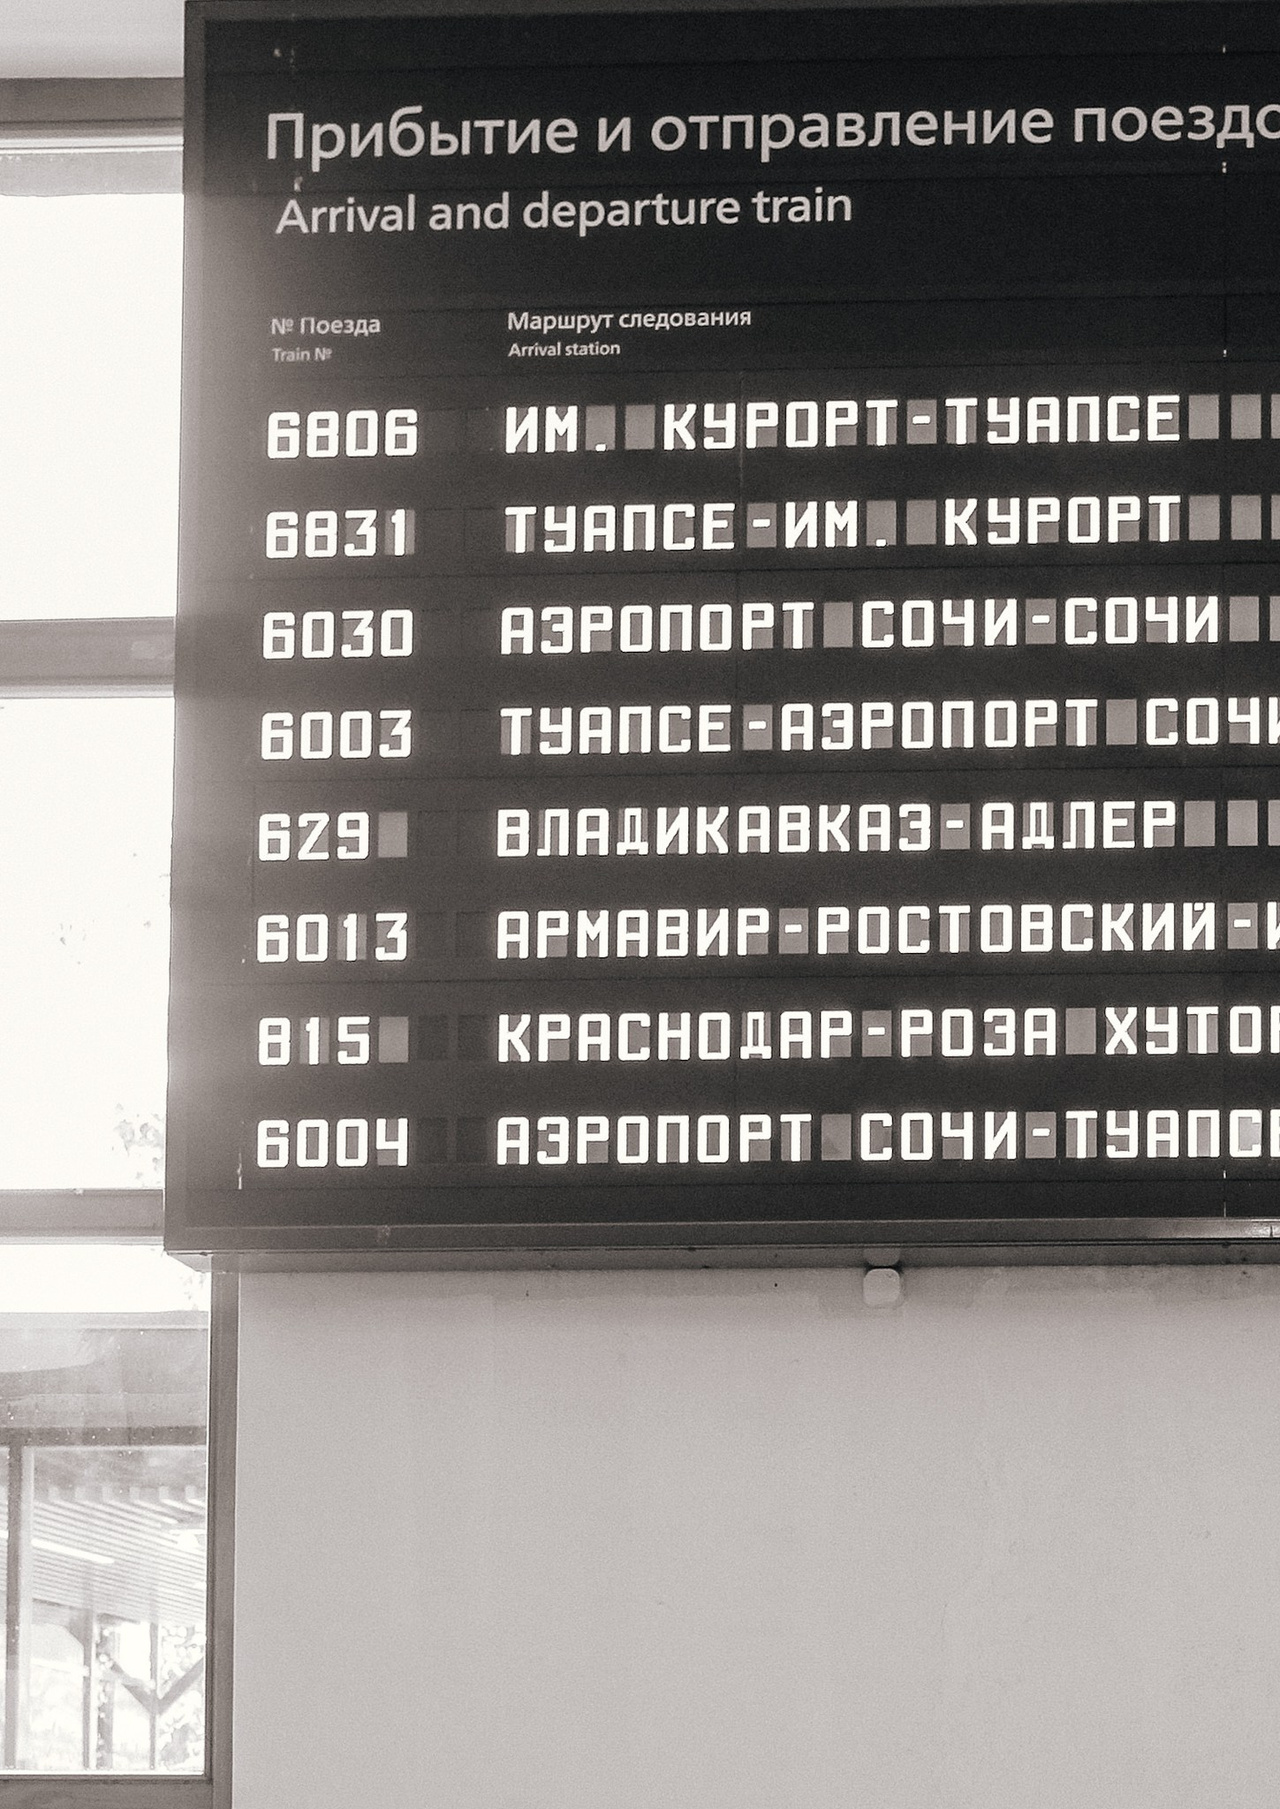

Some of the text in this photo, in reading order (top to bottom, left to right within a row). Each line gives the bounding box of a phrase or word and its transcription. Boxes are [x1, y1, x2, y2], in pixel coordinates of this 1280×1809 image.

[267, 105, 578, 172] Прибытие
[597, 116, 631, 153] и
[650, 108, 1054, 163] отправление
[274, 186, 852, 238] Arrival and departure train
[299, 316, 381, 337] Поезда
[507, 311, 752, 335] Маршрут следования
[271, 347, 310, 362] Train
[507, 340, 621, 358] Arrival station
[267, 409, 418, 459] 6806
[506, 406, 606, 453] ИМ.
[266, 509, 405, 559] 6831
[945, 495, 1181, 546] КУРОРТ
[263, 609, 413, 659] 6030
[501, 602, 814, 655] АЭРОПОРТ
[261, 710, 412, 760] 6003
[258, 812, 369, 861] 629
[257, 912, 407, 963] 6013
[258, 1016, 370, 1066] 815
[257, 1118, 408, 1168] 6004
[497, 1113, 812, 1165] АЭРОПОРТ
